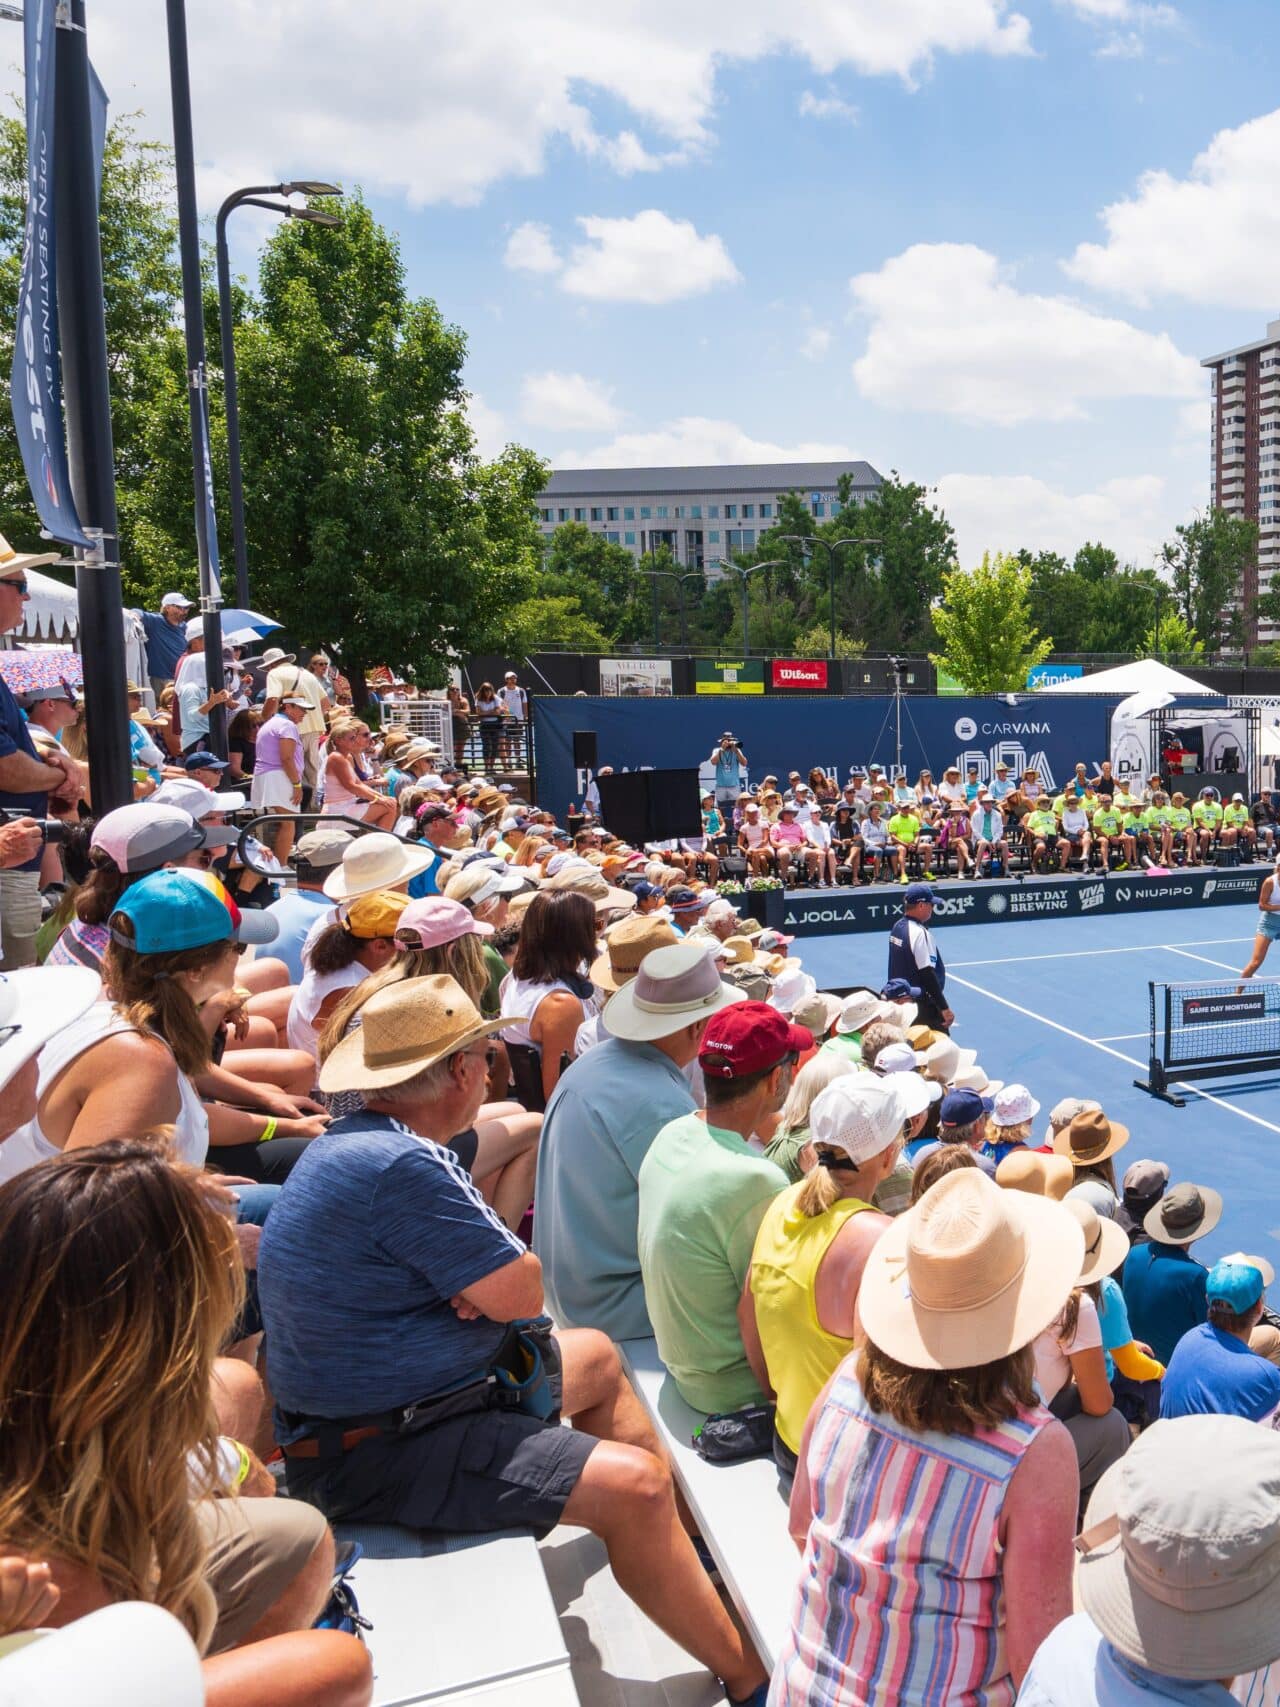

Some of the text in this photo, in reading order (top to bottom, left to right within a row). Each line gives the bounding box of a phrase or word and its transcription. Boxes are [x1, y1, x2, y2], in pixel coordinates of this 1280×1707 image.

[38, 224, 51, 355] SEATING
[46, 364, 54, 402] BY
[780, 669, 819, 681] Wilson
[982, 722, 1051, 735] CARVANA
[1119, 758, 1142, 774] DJ
[1217, 880, 1257, 889] PICKLEBALL
[1010, 890, 1068, 903] BEST DAY
[1079, 883, 1105, 900] VIVA
[1135, 886, 1193, 899] NIUPIPO
[867, 904, 904, 919] TIX
[1010, 900, 1068, 913] BREWING
[799, 909, 856, 924] JOOLA
[1190, 1002, 1262, 1014] SAME DAY MORTGAGE
